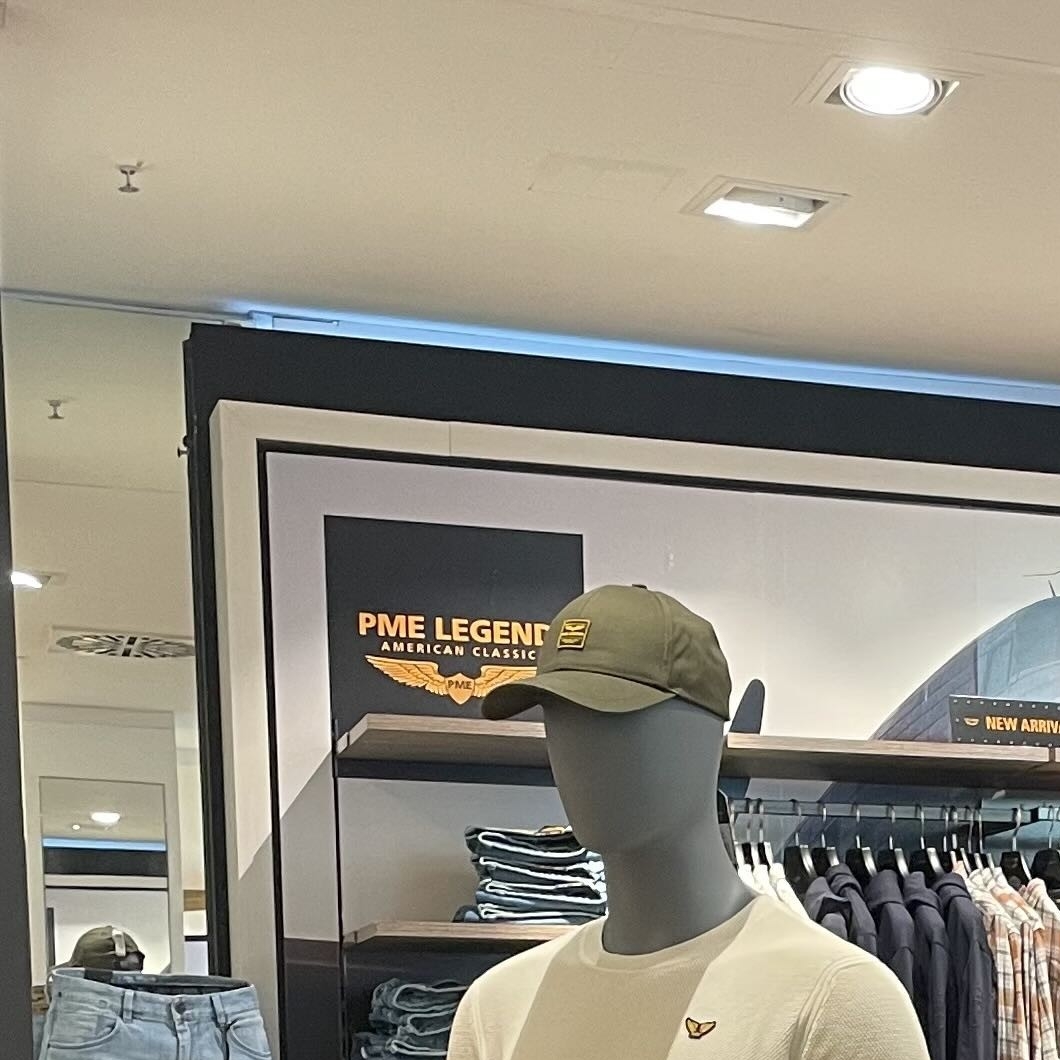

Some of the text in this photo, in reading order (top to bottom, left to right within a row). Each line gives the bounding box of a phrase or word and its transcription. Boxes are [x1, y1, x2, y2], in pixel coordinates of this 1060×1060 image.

[358, 611, 426, 638] PME
[381, 641, 537, 661] AMERICAN CLASSIC
[447, 679, 473, 690] PME
[984, 715, 1018, 731] NEW
